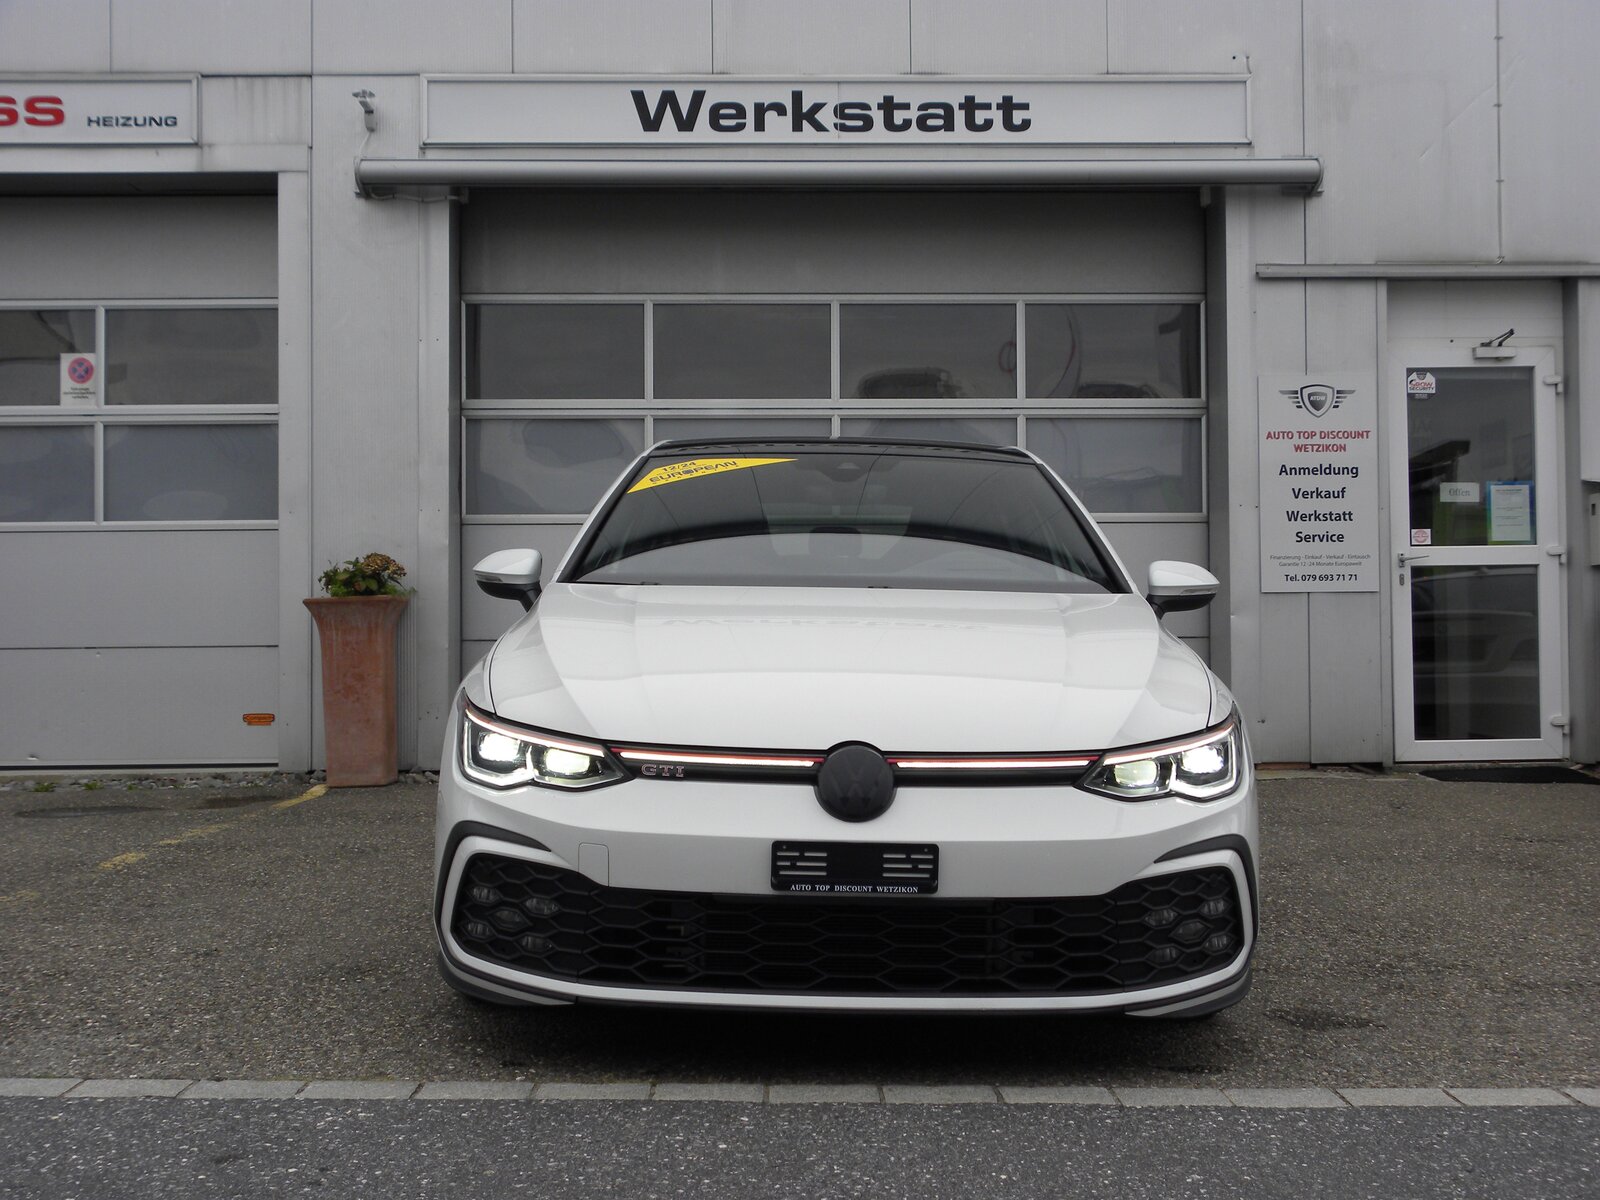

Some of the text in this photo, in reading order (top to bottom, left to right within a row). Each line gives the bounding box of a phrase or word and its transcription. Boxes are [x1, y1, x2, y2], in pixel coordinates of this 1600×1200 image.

[630, 89, 1032, 133] Werkstatt
[86, 115, 178, 127] HEIZUNG
[1266, 430, 1371, 440] AUTO TOP DISCOUNT
[1293, 443, 1347, 453] WETZIKON
[1279, 464, 1359, 478] Anmeldung
[1292, 486, 1347, 499] Verkauf
[1286, 510, 1354, 522] Werkstatt
[1295, 531, 1345, 543] Service
[1284, 574, 1300, 582] Tel.
[1301, 574, 1317, 582] 079
[1318, 574, 1334, 582] 693
[641, 763, 685, 778] GTI
[790, 884, 812, 892] AUTO
[834, 885, 873, 893] DISCOUNT
